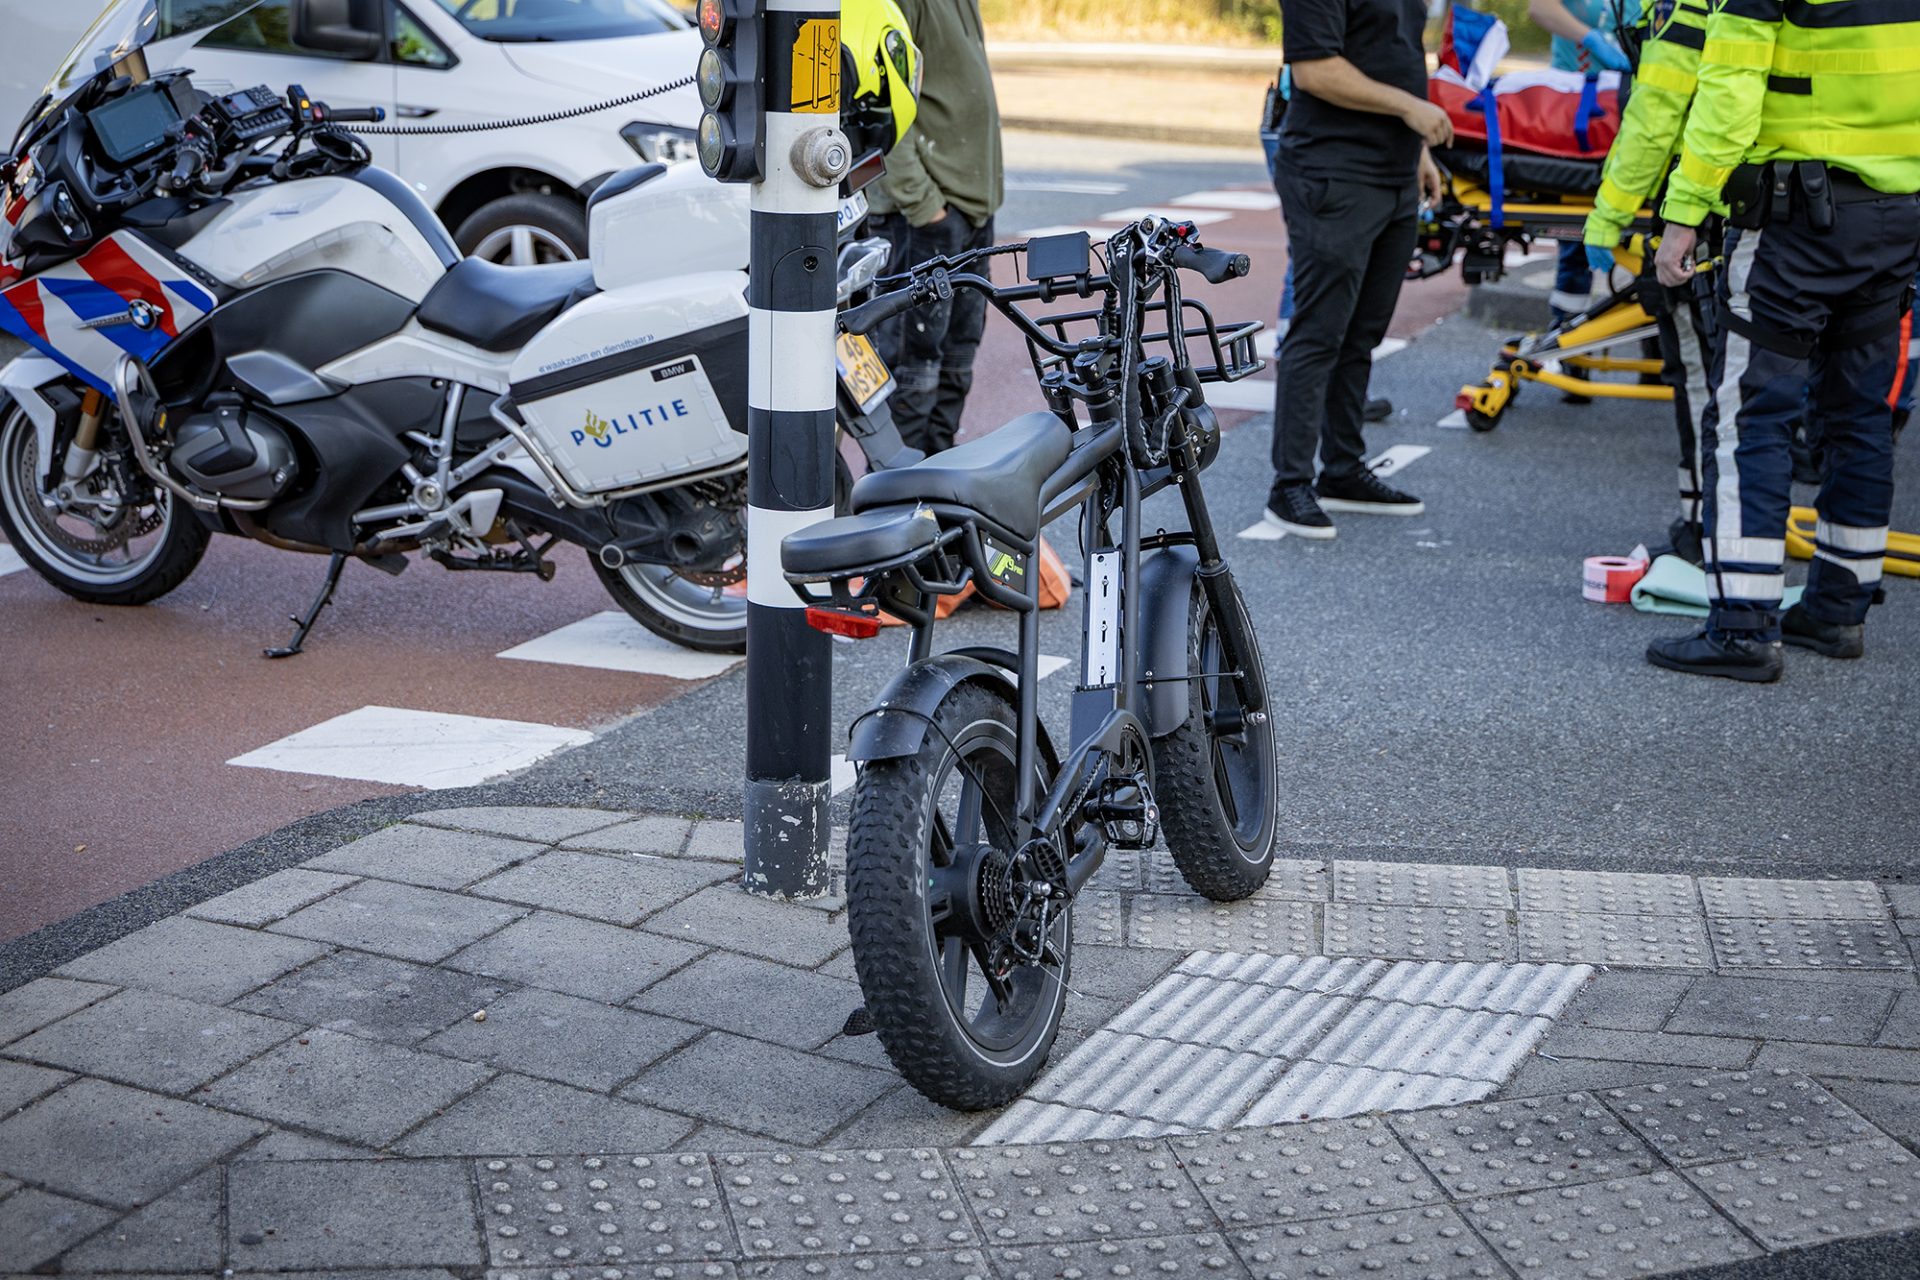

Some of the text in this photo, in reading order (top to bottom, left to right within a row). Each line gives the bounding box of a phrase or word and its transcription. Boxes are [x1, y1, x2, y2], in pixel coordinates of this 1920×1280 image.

[590, 350, 601, 359] en
[660, 363, 685, 378] BMW
[570, 399, 689, 449] POLITIE
[915, 773, 935, 898] KENDA
